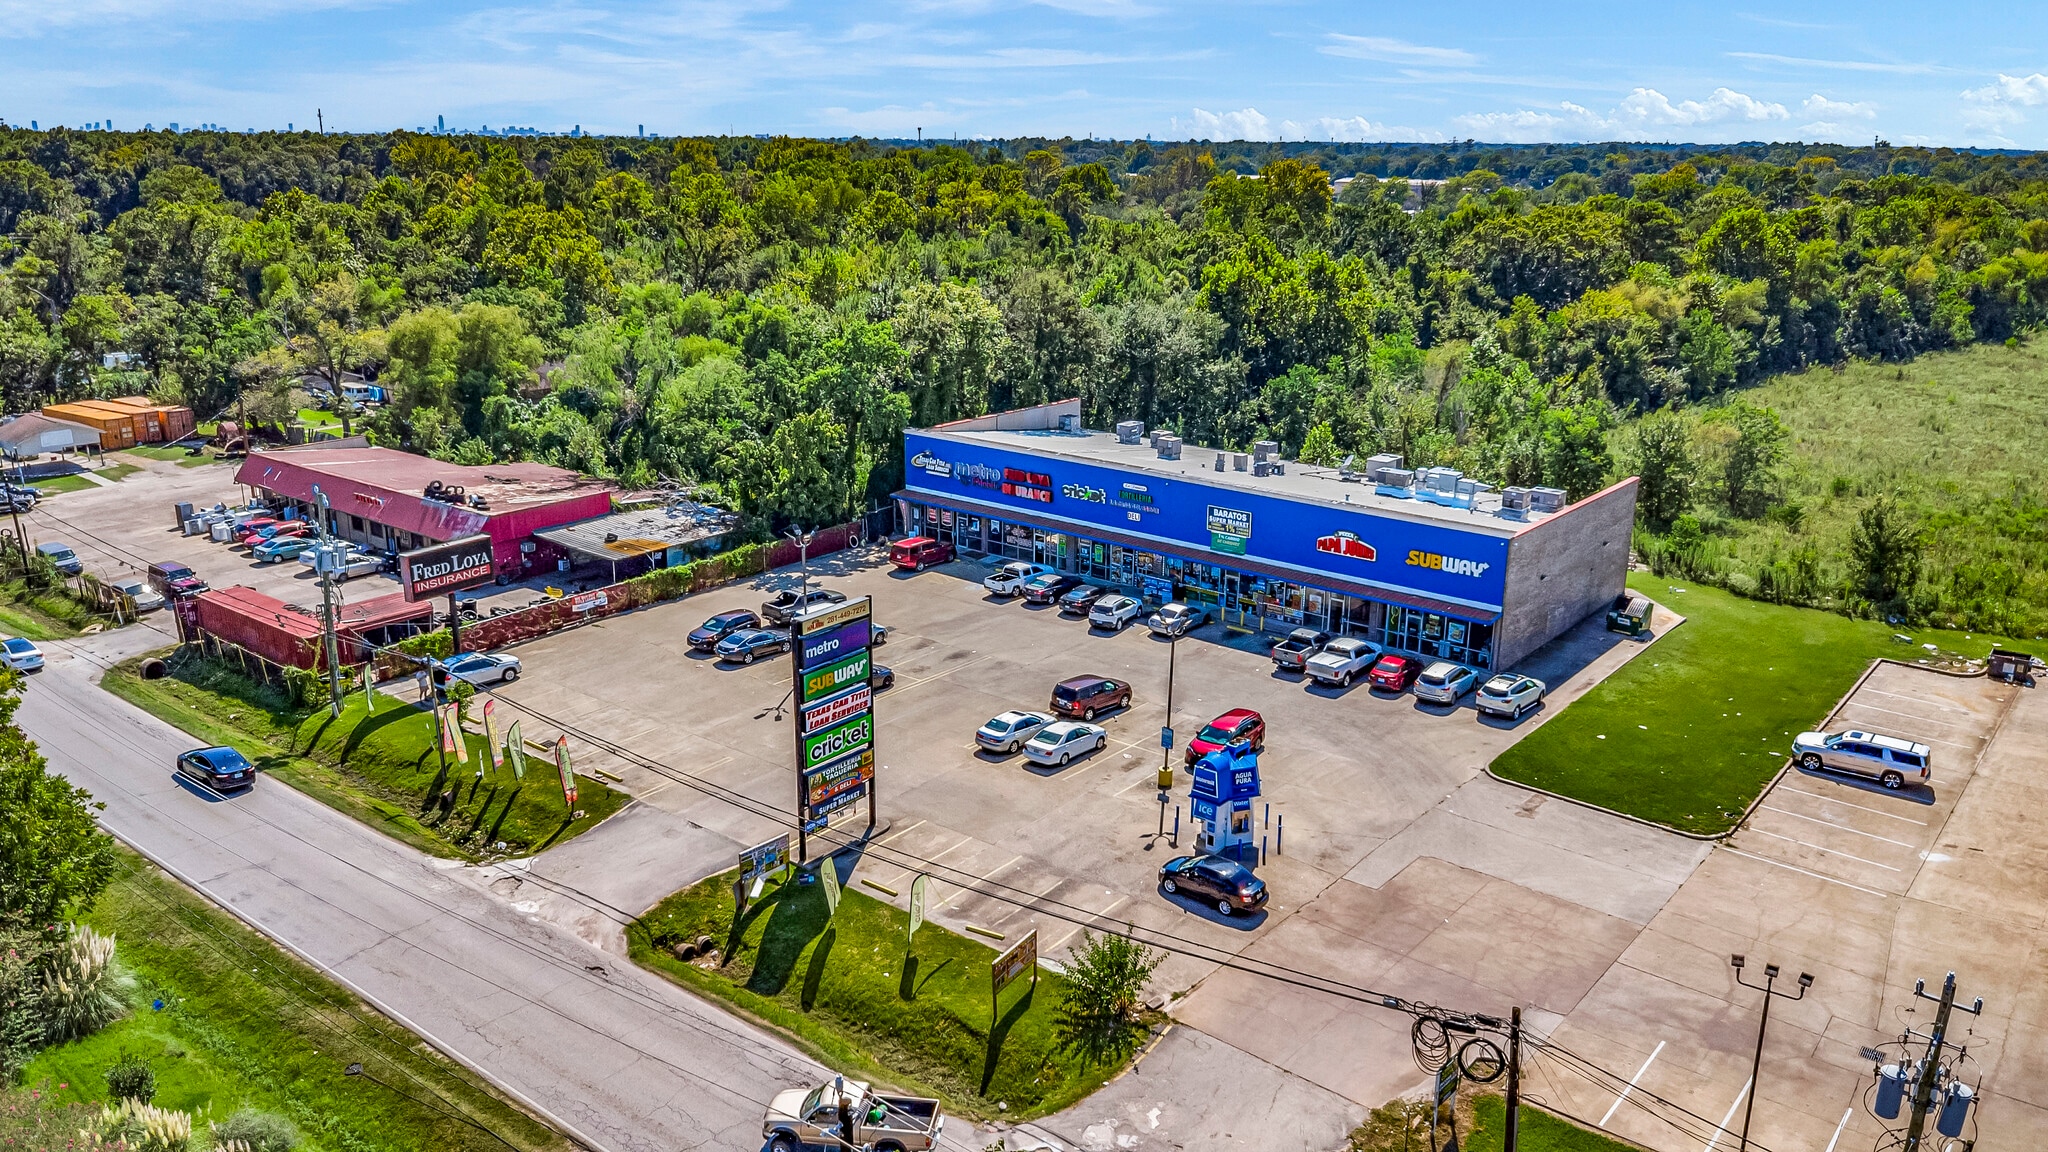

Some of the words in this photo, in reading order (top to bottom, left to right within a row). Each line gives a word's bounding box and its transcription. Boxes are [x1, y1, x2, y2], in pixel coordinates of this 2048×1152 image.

[954, 461, 1001, 481] metro
[1002, 482, 1051, 503] INSURANCE
[1062, 483, 1106, 505] cricket
[1128, 511, 1141, 521] DELI
[1209, 515, 1227, 525] SUPER
[1227, 518, 1249, 528] MARKET
[1213, 508, 1247, 522] BARATOS
[1405, 550, 1490, 578] SUBWAY
[416, 565, 488, 591] INSURANCE
[826, 604, 866, 624] 281-449-7272
[806, 639, 839, 658] metro
[807, 659, 867, 695] SUBWAY
[810, 721, 870, 761] cricket
[822, 754, 862, 776] TORTILLERIA
[826, 762, 859, 781] TAQUERIA
[840, 780, 852, 790] DELI
[1235, 772, 1252, 780] AGUA
[1235, 777, 1252, 785] PURA
[819, 800, 838, 815] SUPER
[838, 790, 860, 806] MARKET
